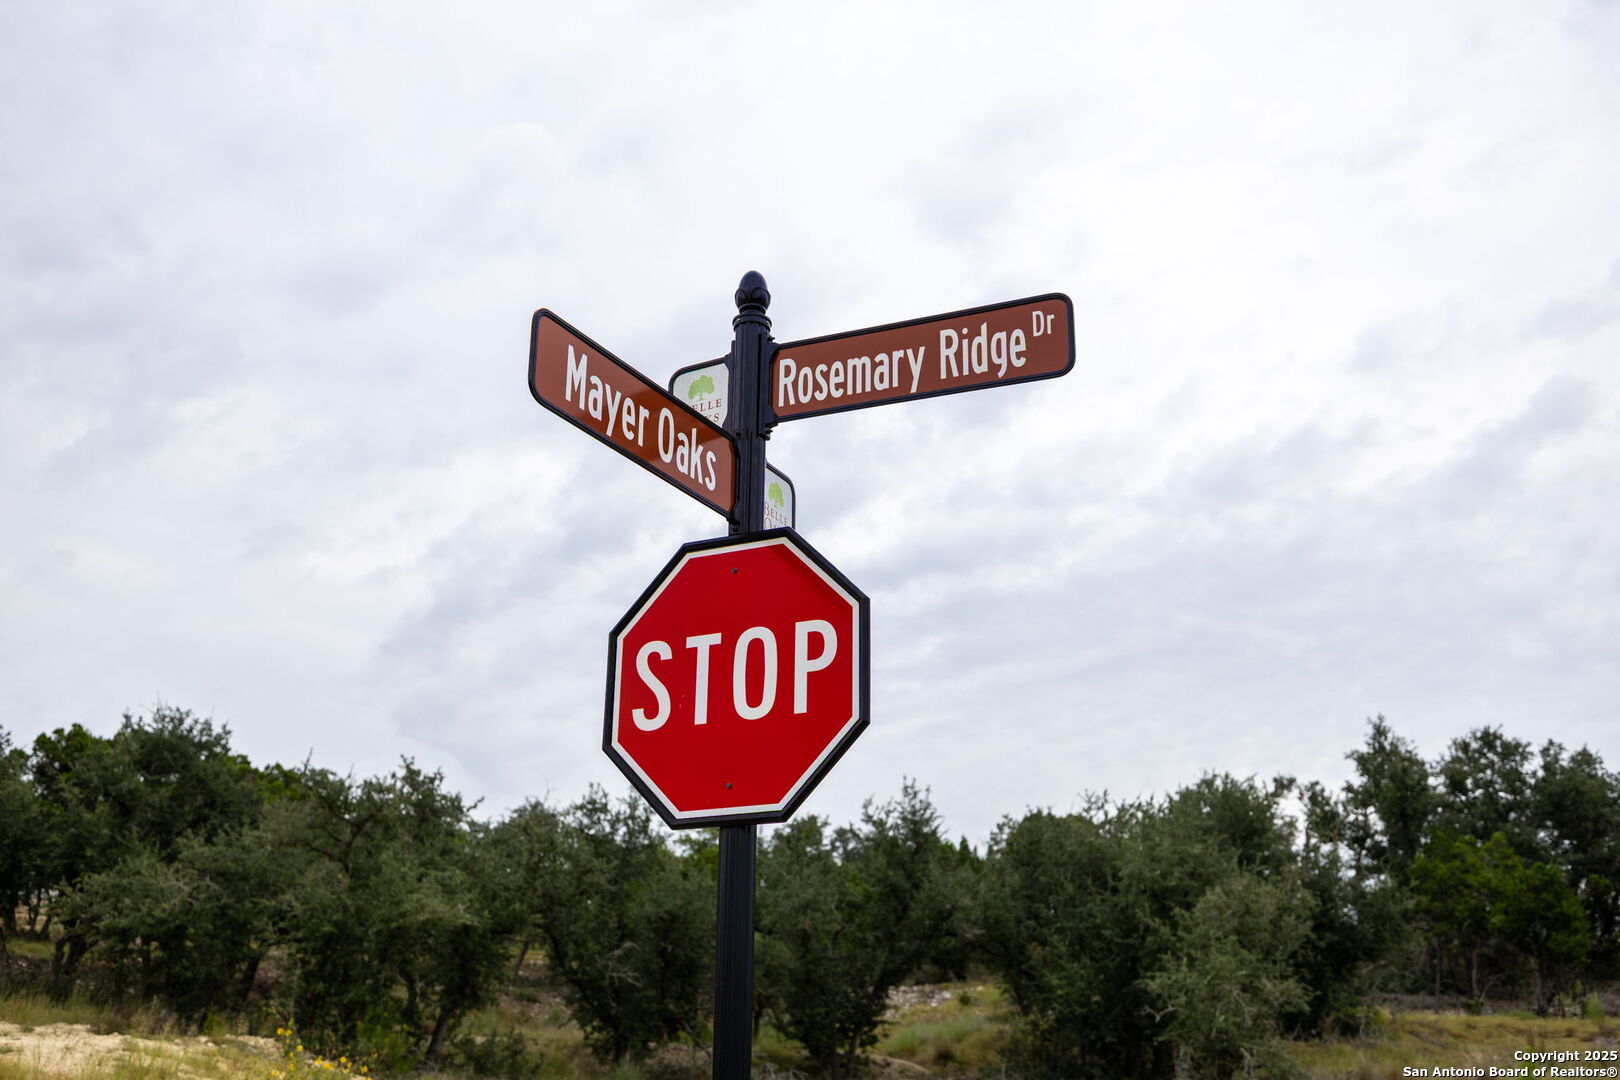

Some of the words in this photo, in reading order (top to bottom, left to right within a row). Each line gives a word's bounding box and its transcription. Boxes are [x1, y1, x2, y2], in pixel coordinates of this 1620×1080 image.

[692, 399, 722, 411] ELLE
[778, 346, 925, 407] Rosemary
[939, 321, 1027, 378] Ridge
[1032, 310, 1055, 337] Dr
[565, 344, 650, 447] Mayer
[658, 407, 717, 491] Oaks
[631, 619, 838, 732] STOP
